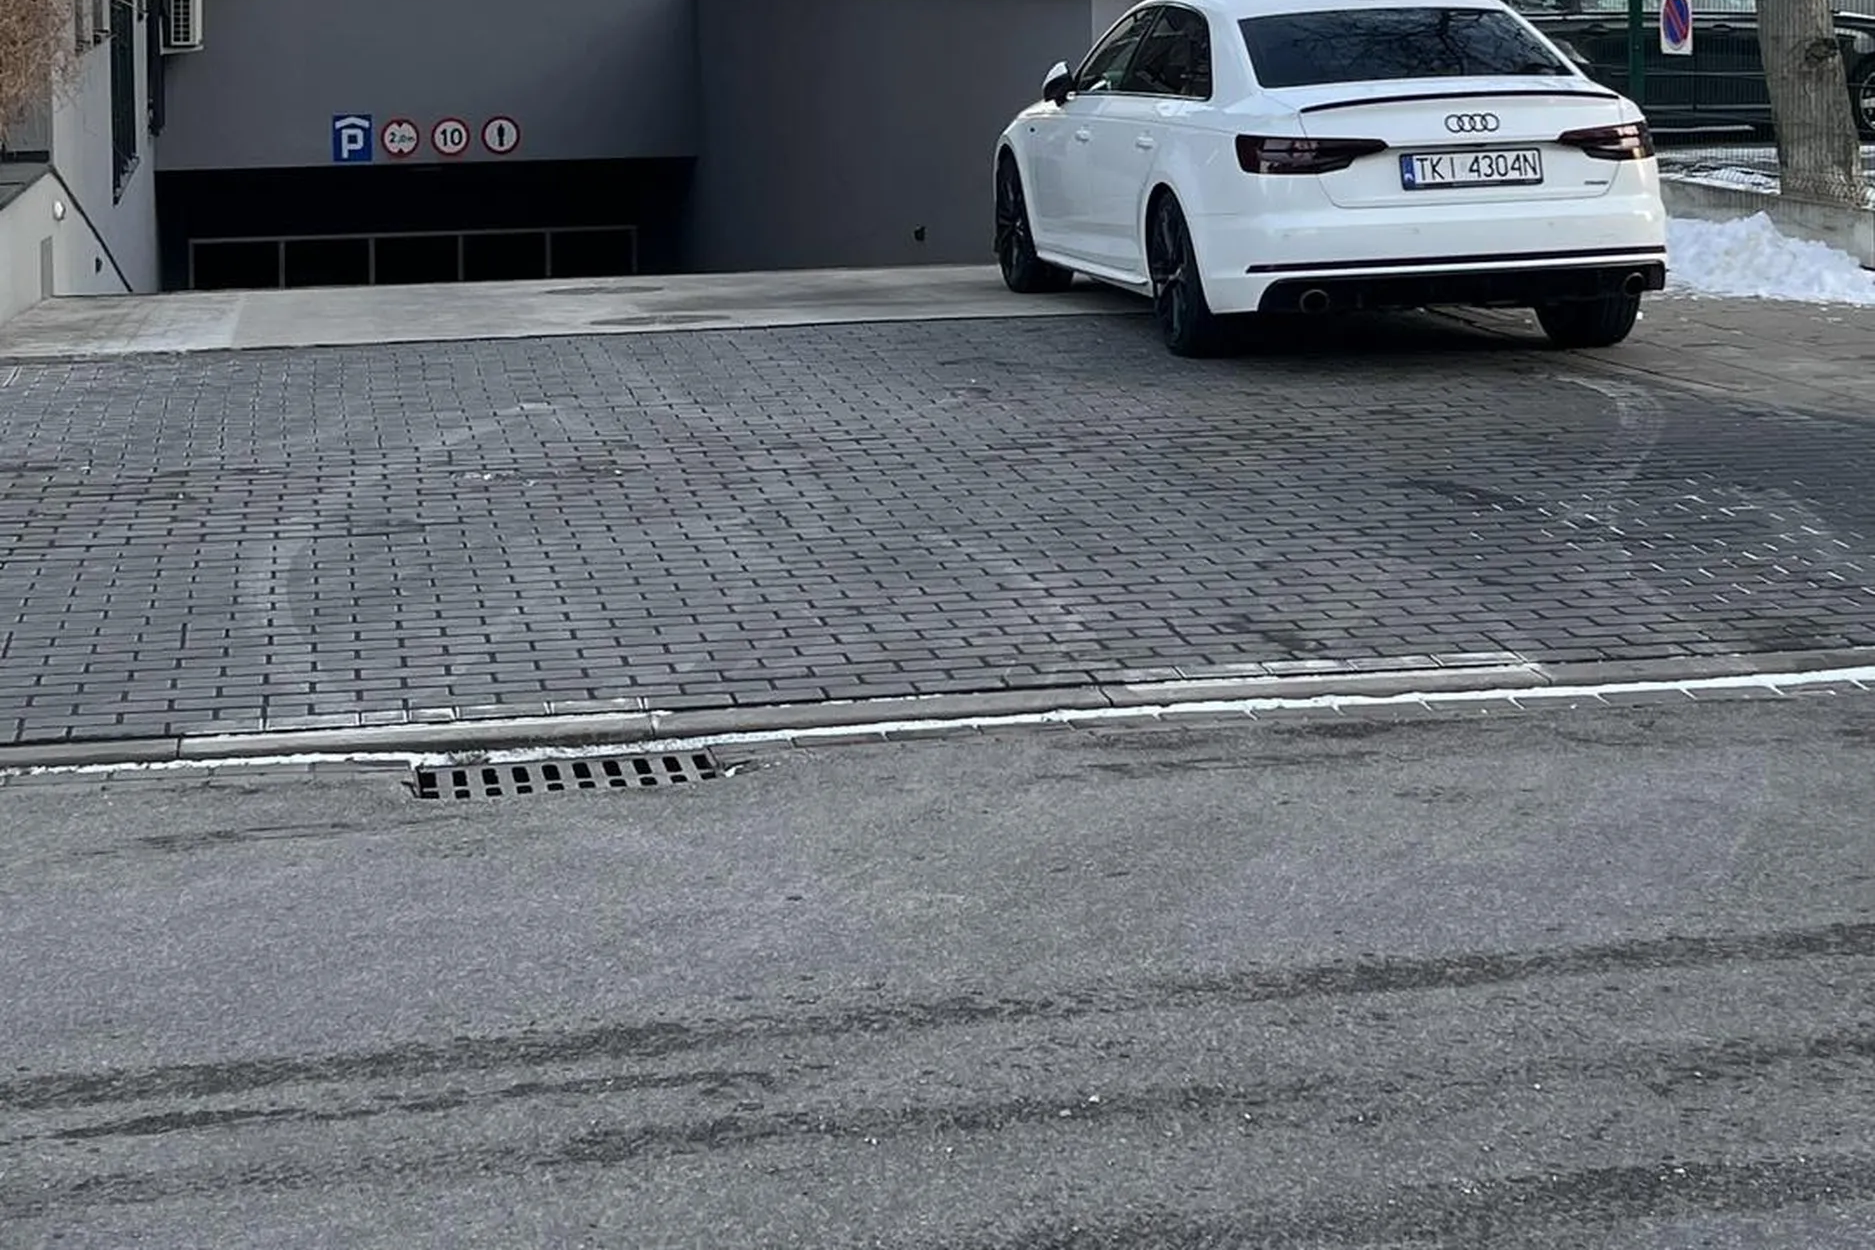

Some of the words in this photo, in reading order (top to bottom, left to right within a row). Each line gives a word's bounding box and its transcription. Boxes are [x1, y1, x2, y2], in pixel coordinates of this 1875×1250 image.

[341, 128, 364, 158] P
[441, 128, 463, 146] 10
[1416, 156, 1455, 181] TKI
[1468, 152, 1538, 178] 4304N
